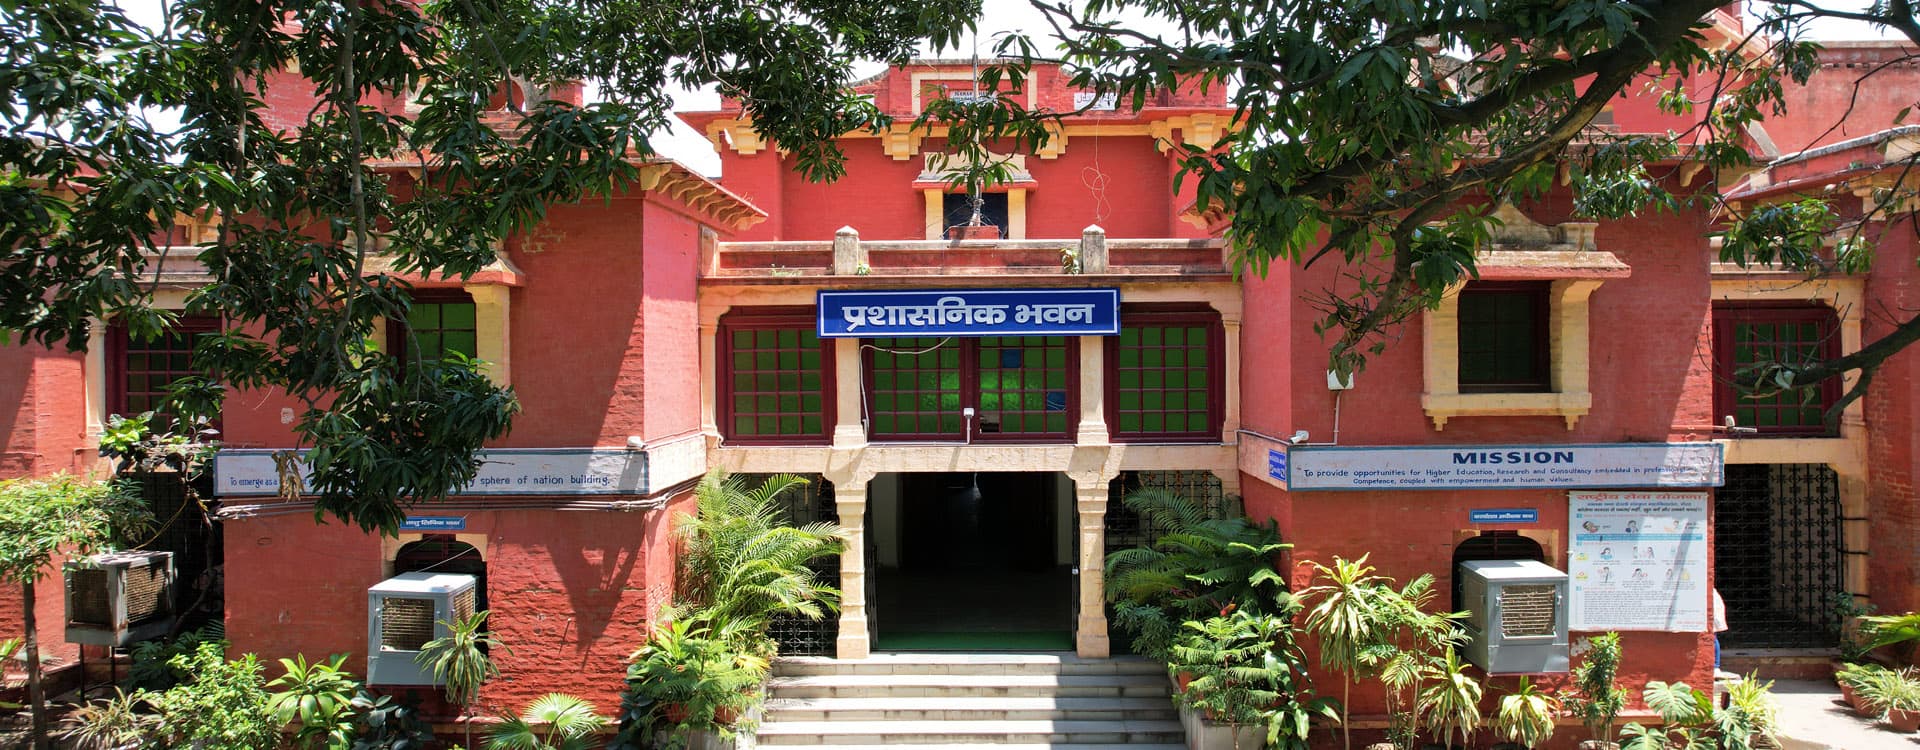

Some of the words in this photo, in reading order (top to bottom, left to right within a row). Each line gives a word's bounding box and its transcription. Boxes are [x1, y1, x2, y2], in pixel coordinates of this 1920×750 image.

[842, 296, 1010, 332] प्रशासनिक
[1015, 303, 1096, 324] भवन
[1452, 451, 1575, 464] MISSION
[1304, 469, 1314, 477] To
[1316, 469, 1349, 477] provide
[1353, 468, 1406, 478] opportunities
[1409, 468, 1422, 476] for
[1426, 468, 1451, 478] Higher
[1456, 468, 1495, 477] Education,
[1497, 468, 1530, 476] Research
[1533, 467, 1546, 475] and
[1550, 467, 1592, 476] Consultancy
[1595, 466, 1631, 474] embedded
[1632, 466, 1641, 474] in
[230, 476, 238, 486] To
[239, 477, 264, 488] emerge
[480, 475, 511, 487] sphere
[517, 475, 529, 485] of
[533, 475, 564, 485] nation
[570, 474, 611, 486] building.
[1353, 477, 1397, 486] Competence,
[1399, 477, 1426, 486] coupled
[1448, 477, 1500, 486] empowerment
[1502, 476, 1515, 484] and
[1576, 492, 1619, 502] राष्ट्रीय
[1623, 492, 1651, 501] सेवा
[1655, 492, 1702, 501] योजना
